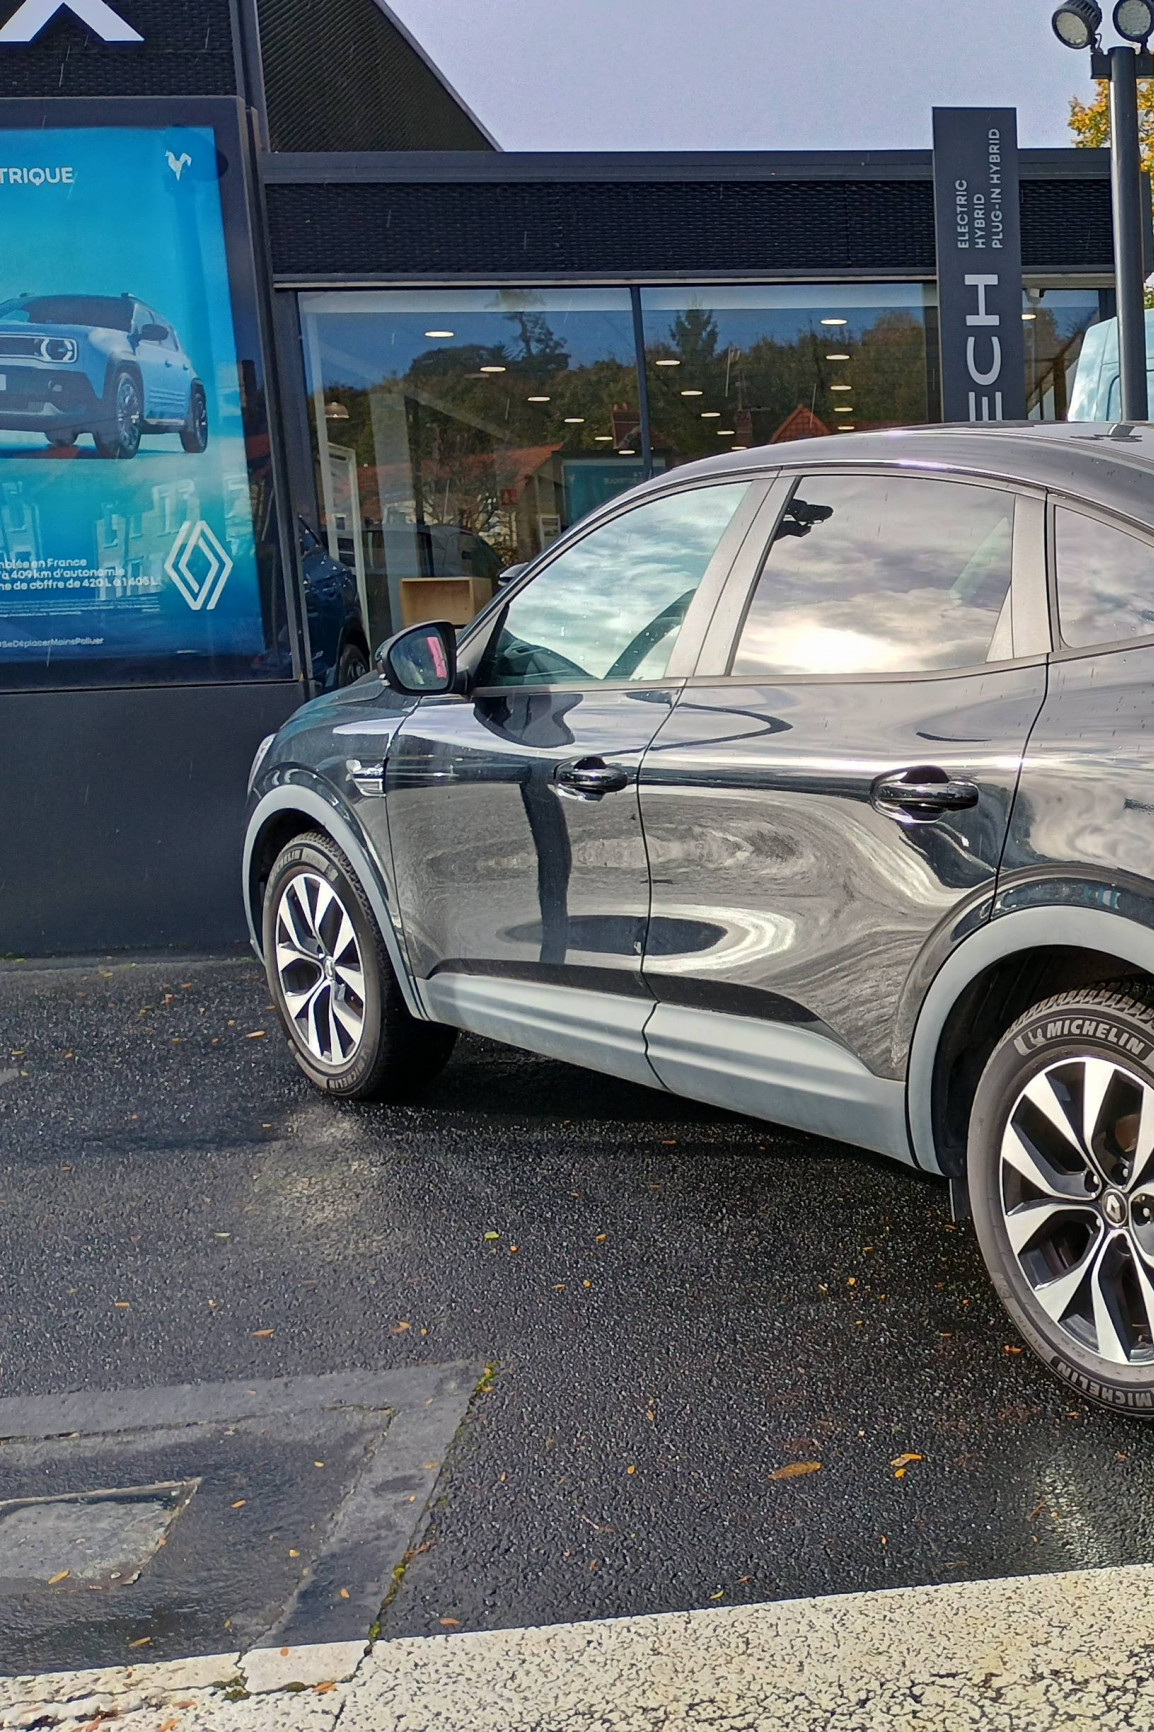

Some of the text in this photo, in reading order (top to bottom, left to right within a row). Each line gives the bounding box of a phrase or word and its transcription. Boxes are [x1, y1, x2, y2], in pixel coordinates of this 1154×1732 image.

[989, 128, 1003, 249] PLUG-IN HYBRID
[955, 179, 969, 249] ELECTRIC
[974, 193, 986, 249] HYBRID
[31, 559, 45, 569] en
[47, 558, 87, 567] France
[53, 567, 125, 578] d'autonomie
[13, 581, 28, 590] de
[30, 580, 64, 589] coffre
[66, 579, 80, 588] de
[1046, 1019, 1146, 1056] MICHELIN
[1056, 1361, 1153, 1407] MICHELIN
